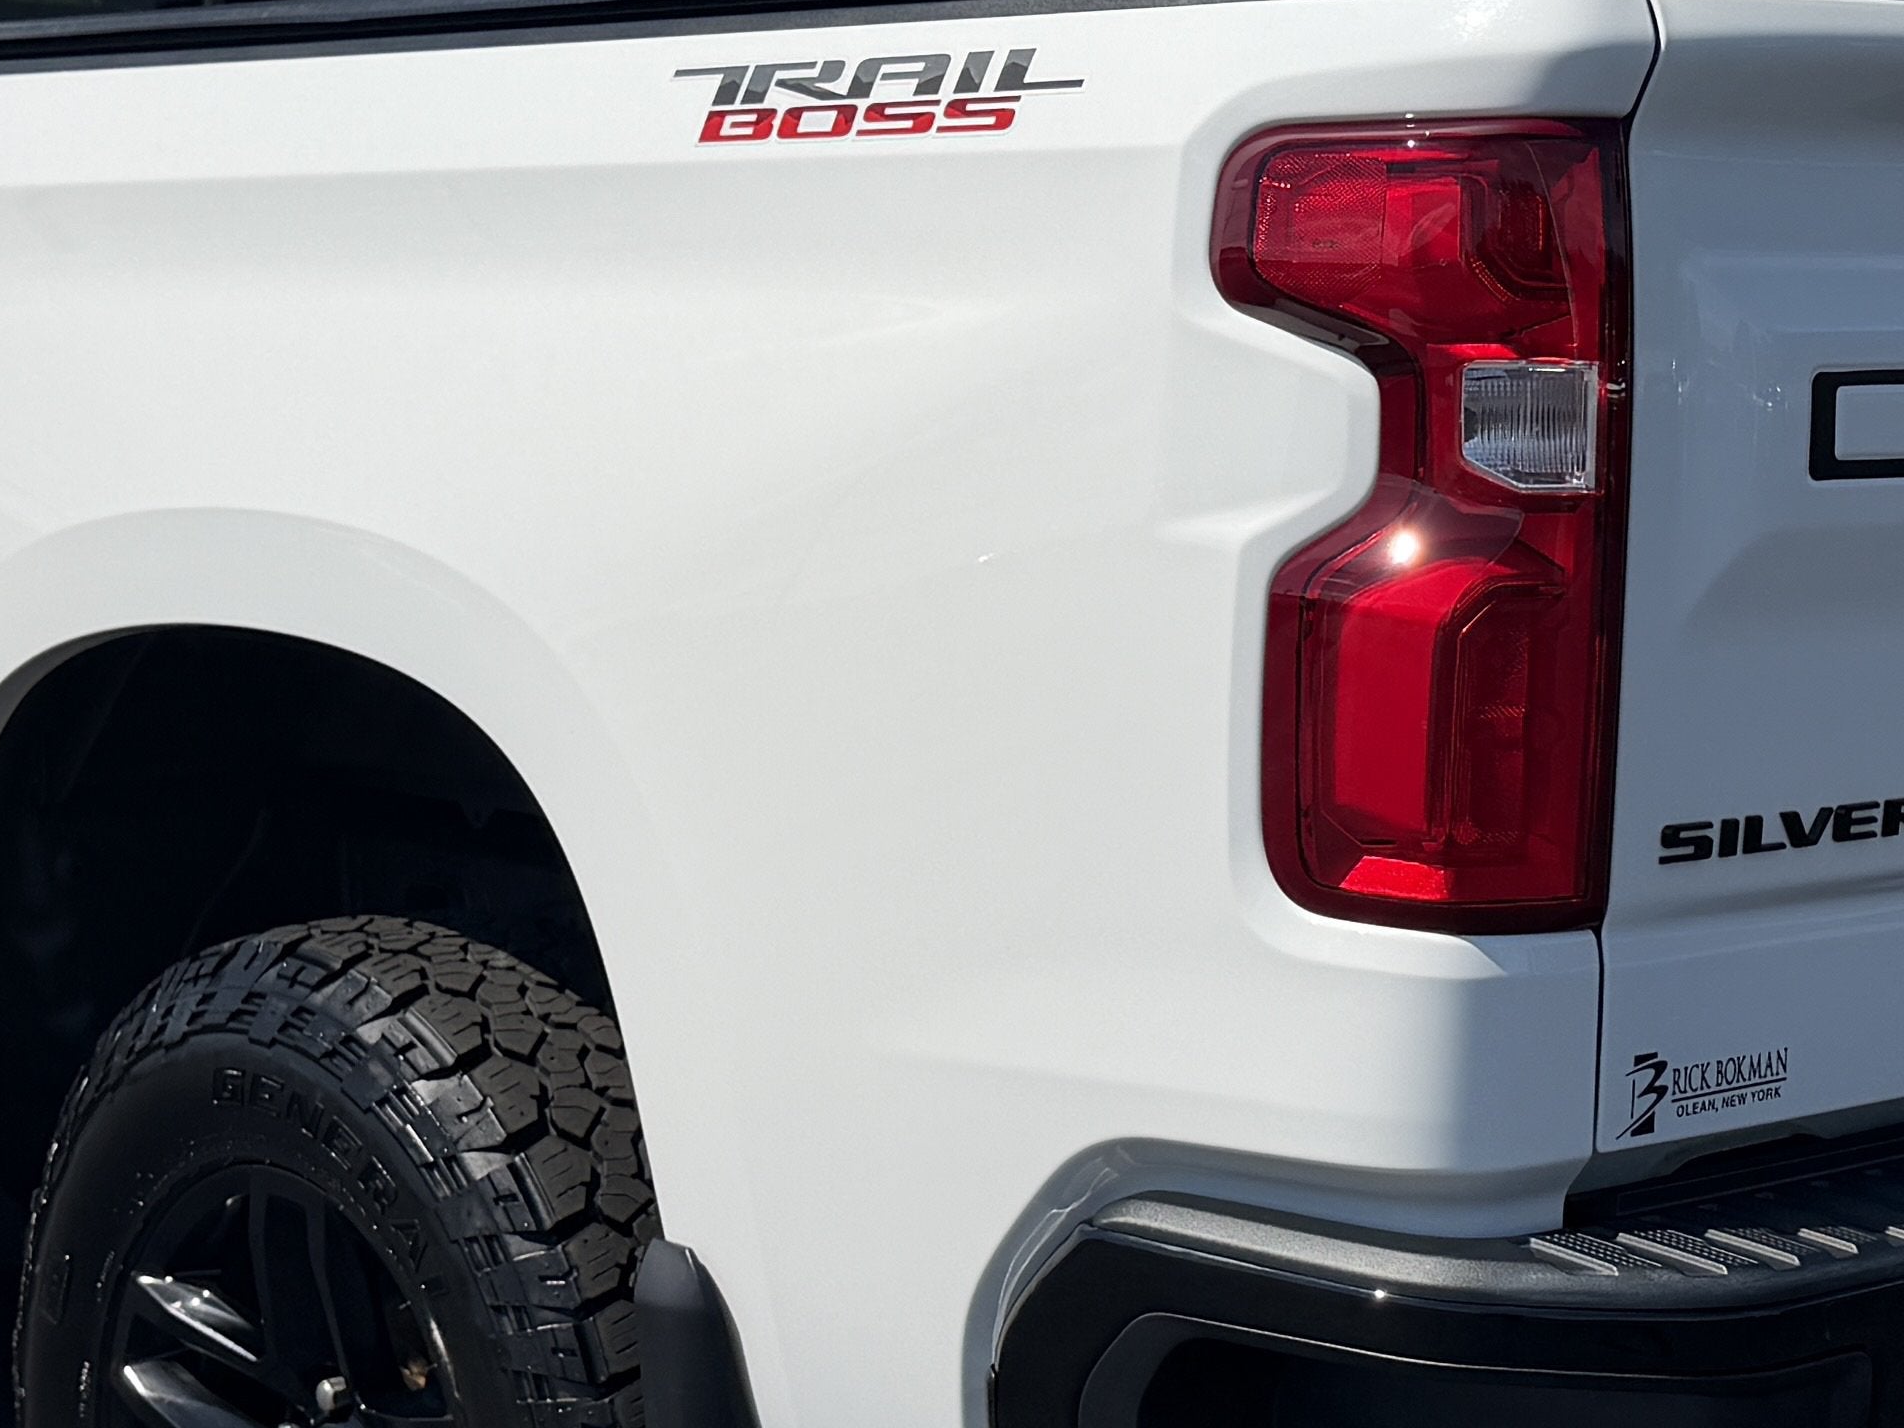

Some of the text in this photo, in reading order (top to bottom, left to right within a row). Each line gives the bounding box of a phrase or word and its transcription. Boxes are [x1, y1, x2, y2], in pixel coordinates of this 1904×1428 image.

[674, 47, 1085, 106] TRAIL
[697, 95, 1021, 143] BOSS
[1672, 1047, 1788, 1095] RICK BOKMAN
[1676, 1086, 1782, 1118] OLEAN, NEW YORK
